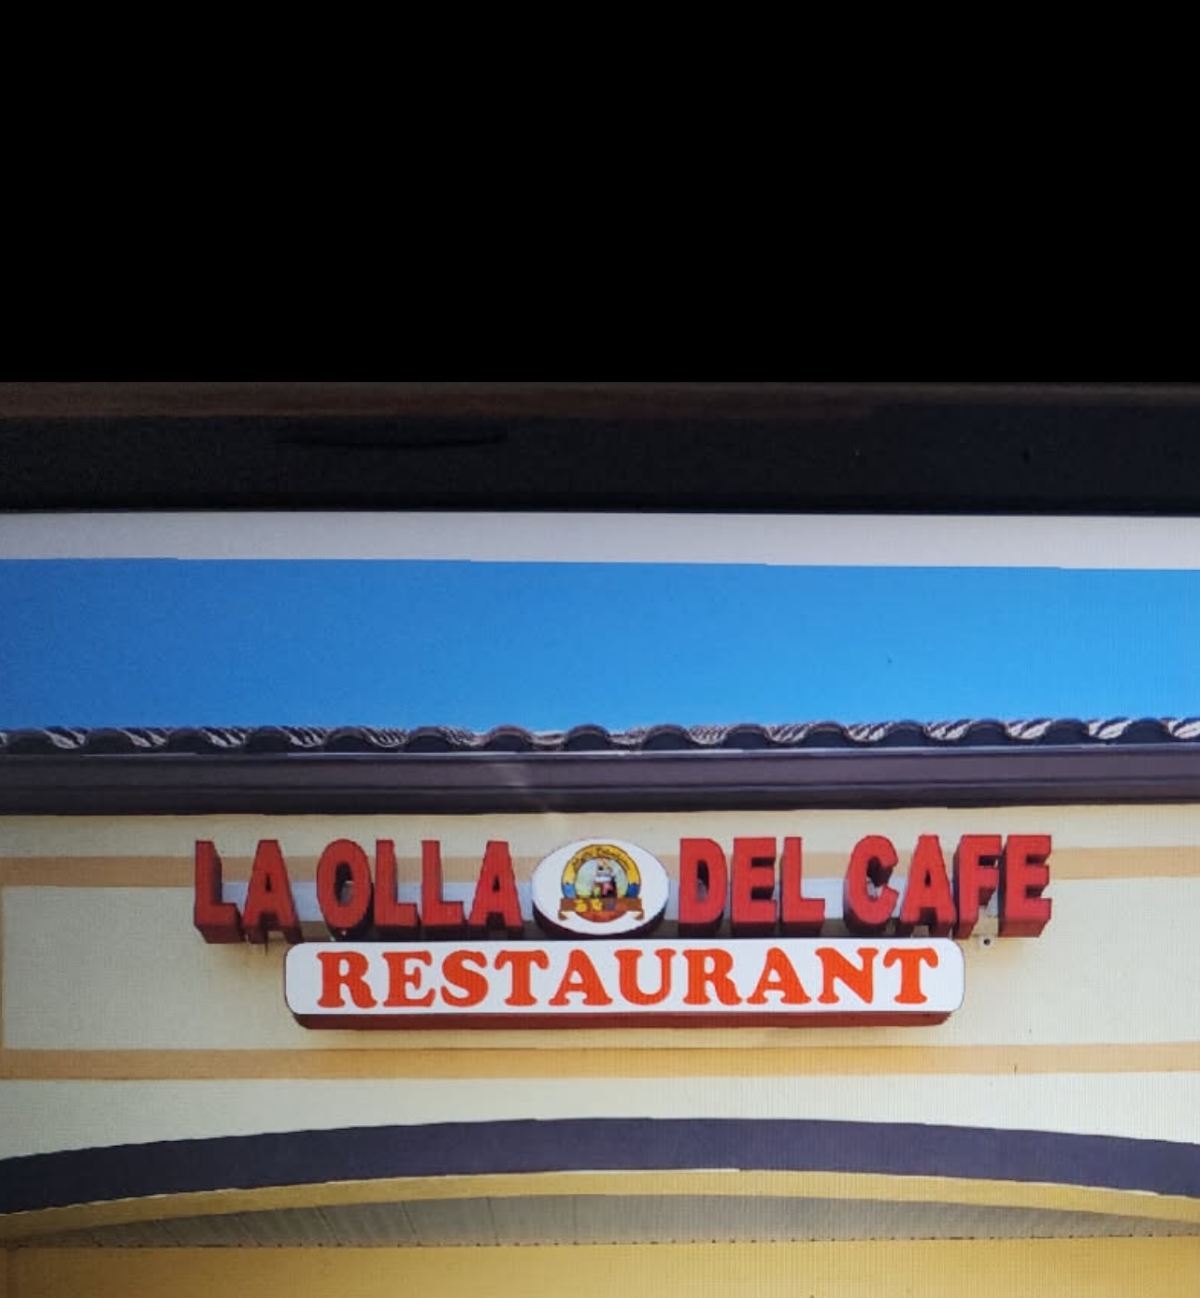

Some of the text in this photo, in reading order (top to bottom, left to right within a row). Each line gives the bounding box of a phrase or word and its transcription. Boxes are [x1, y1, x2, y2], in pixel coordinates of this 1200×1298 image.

[194, 834, 1052, 932] LA OLLA DEL CAFE
[316, 946, 939, 1007] RESTAURANT
